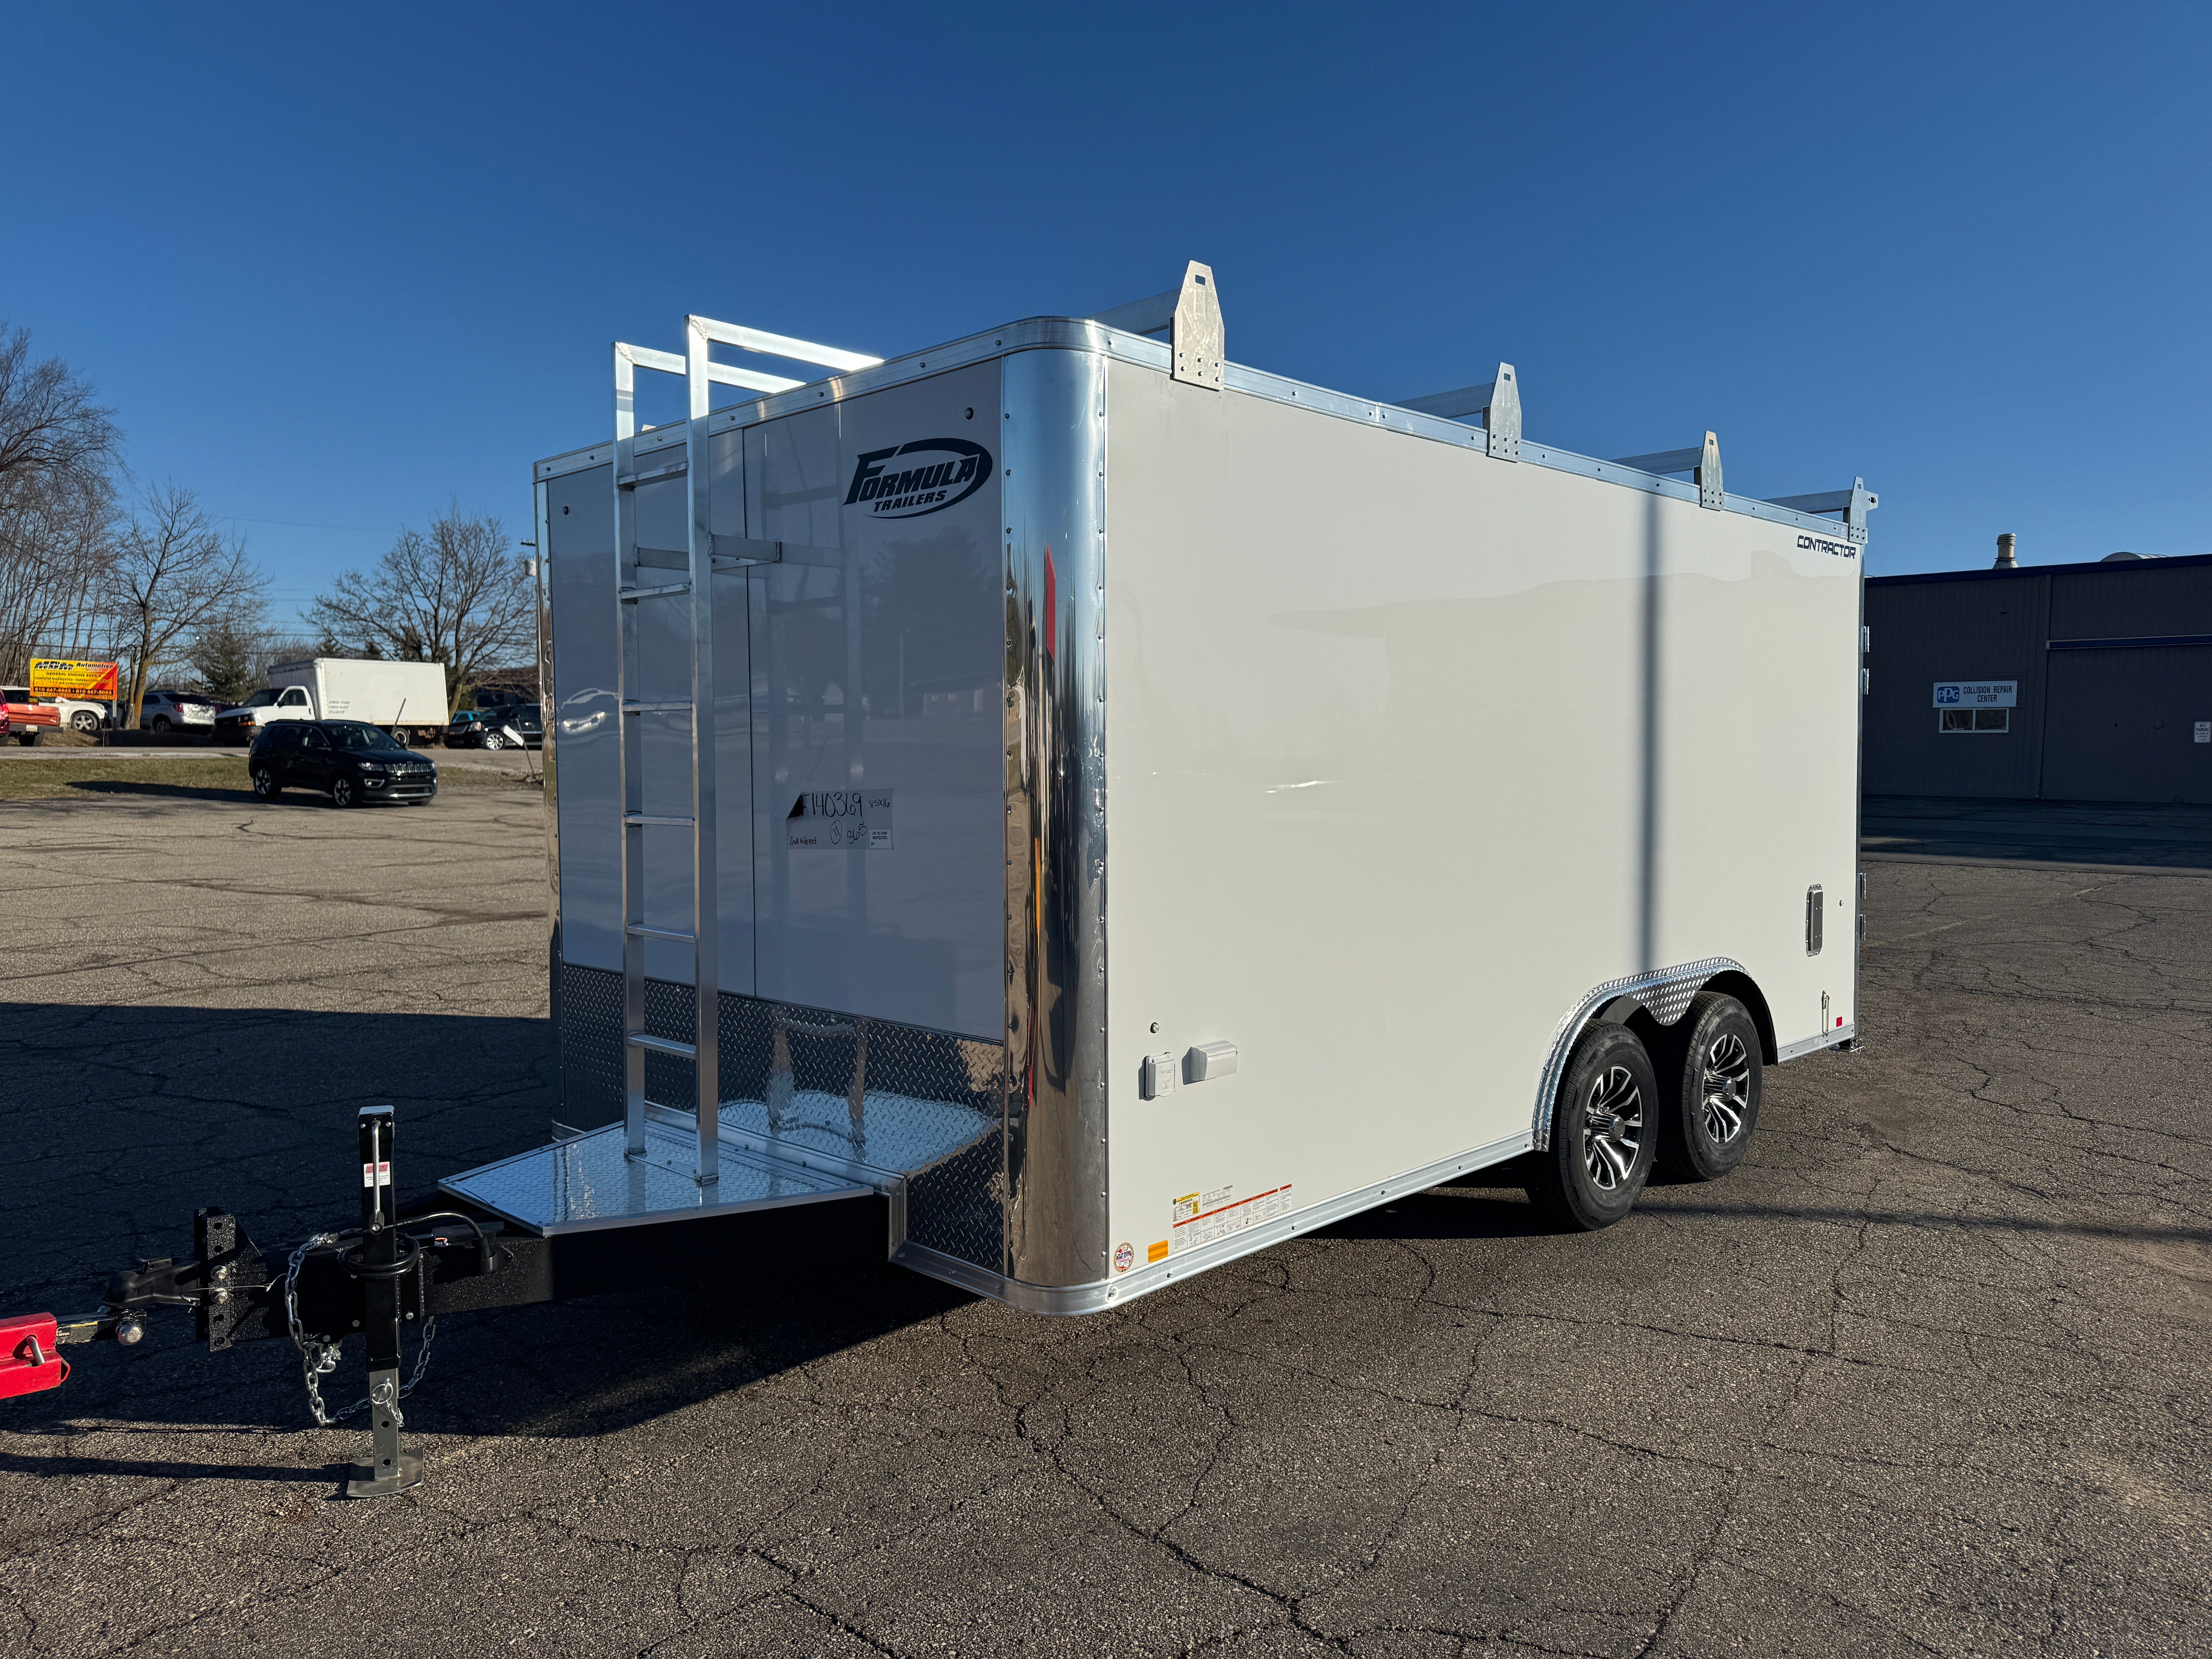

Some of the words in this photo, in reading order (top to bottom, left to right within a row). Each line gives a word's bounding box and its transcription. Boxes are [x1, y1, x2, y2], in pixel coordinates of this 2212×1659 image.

[843, 446, 978, 505] FORMULA
[874, 490, 947, 512] TRAILERS
[1797, 535, 1856, 559] CONTRACTOR
[1938, 687, 1959, 702] PPG
[847, 821, 867, 844] 365
